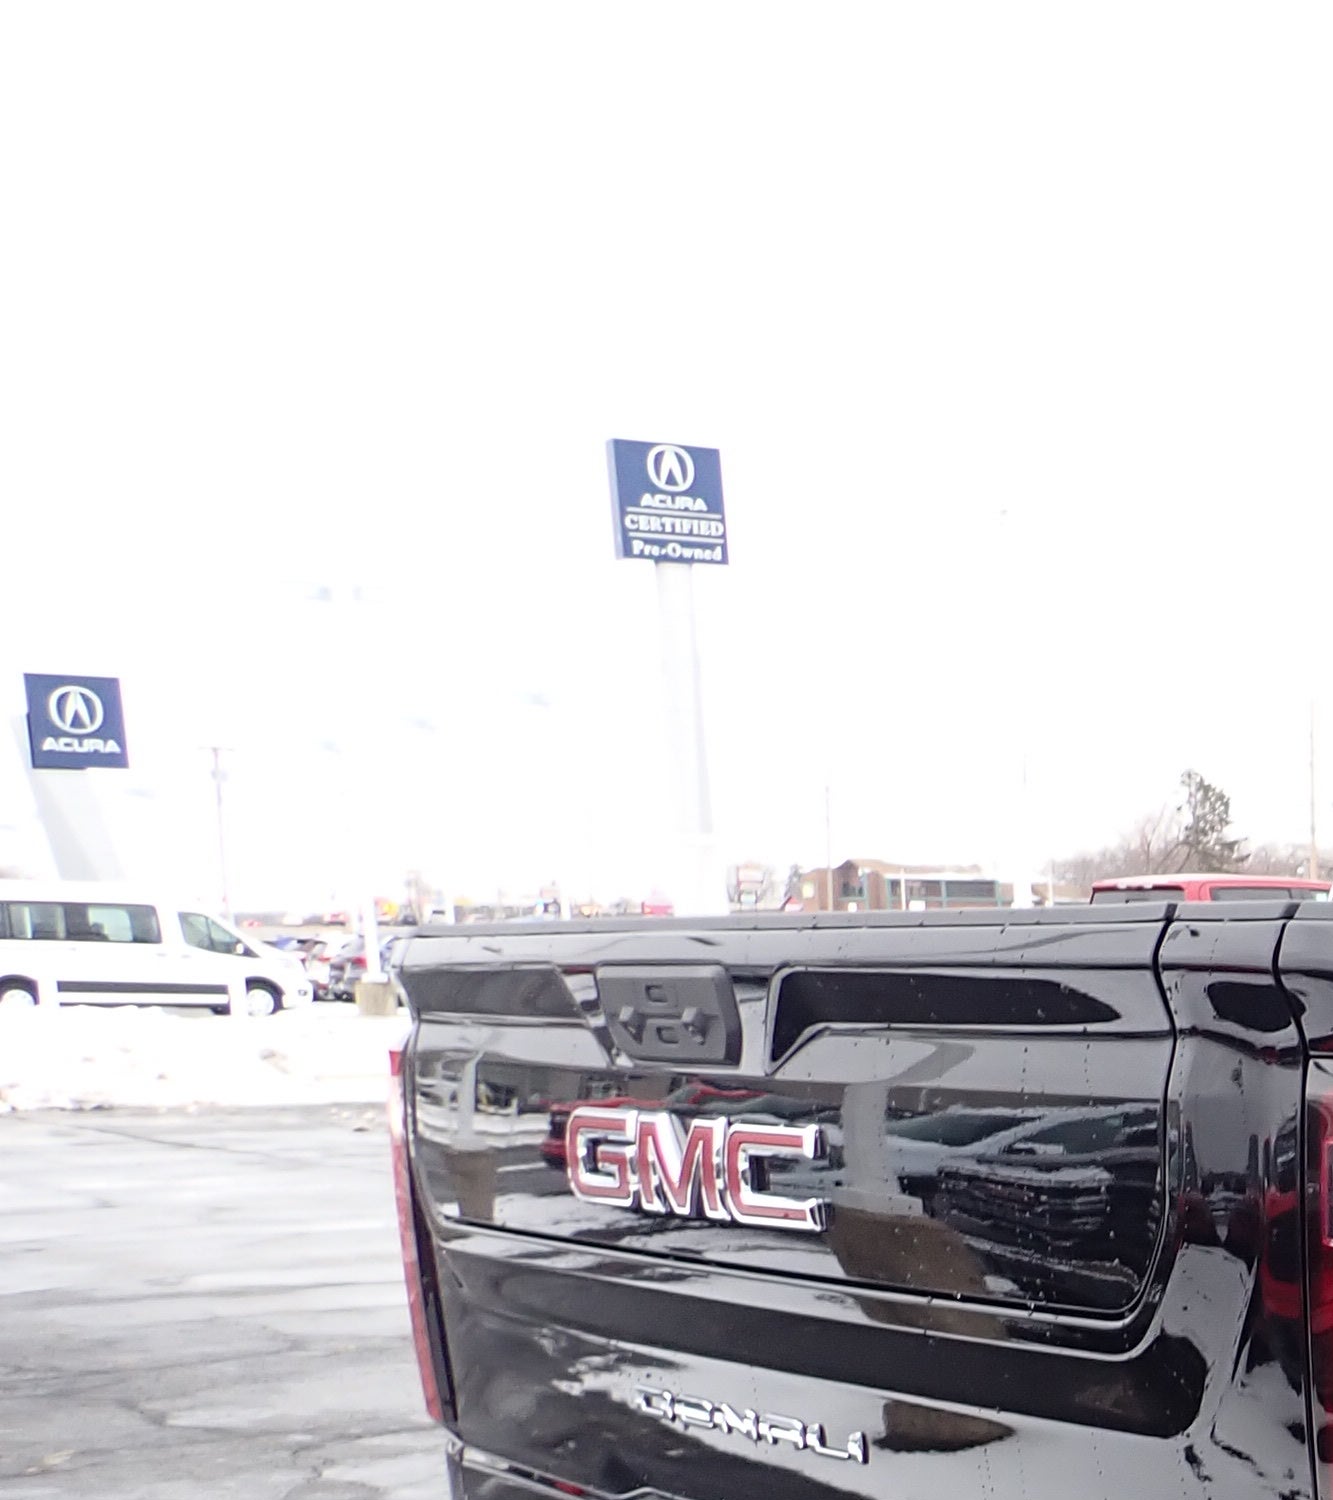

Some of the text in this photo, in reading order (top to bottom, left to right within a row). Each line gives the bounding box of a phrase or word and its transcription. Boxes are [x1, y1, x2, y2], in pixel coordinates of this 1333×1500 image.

[640, 493, 708, 512] ACURA
[624, 514, 725, 537] CERTIFIED
[632, 539, 722, 561] Pre-Owned
[42, 737, 121, 754] ACURA
[566, 1106, 827, 1232] GMC
[632, 1384, 869, 1464] DENALI
